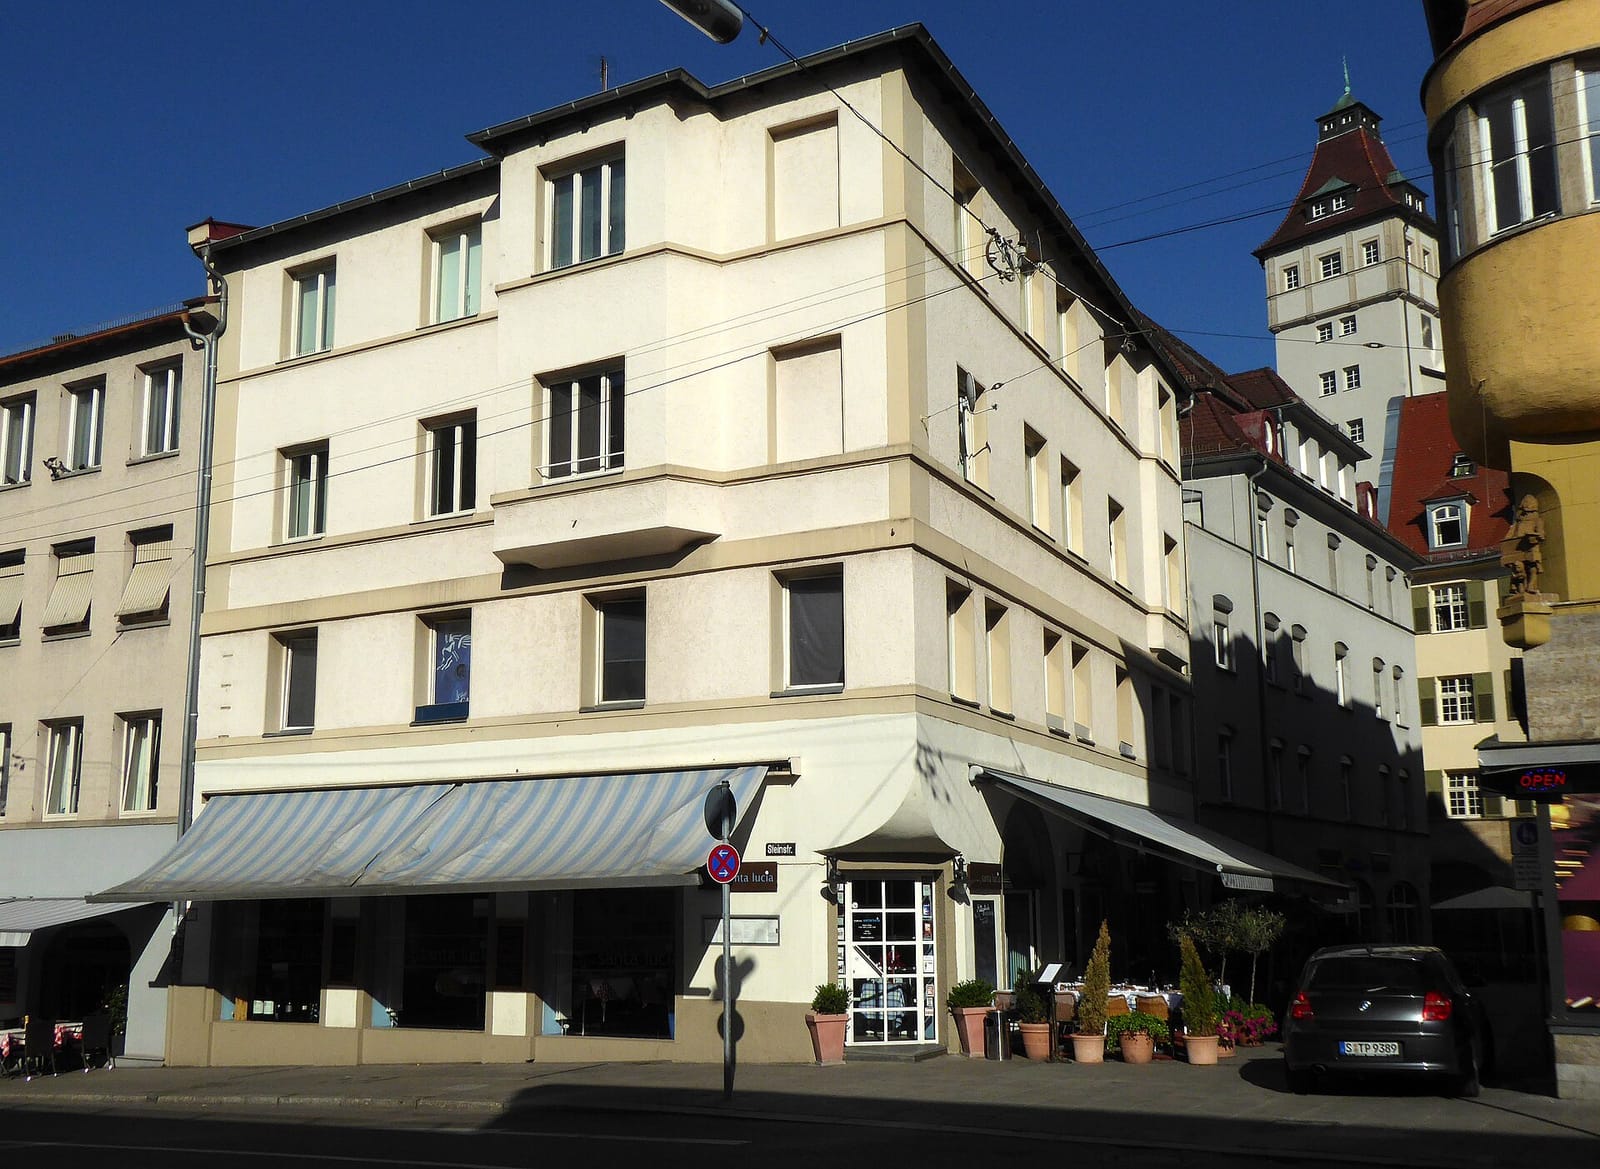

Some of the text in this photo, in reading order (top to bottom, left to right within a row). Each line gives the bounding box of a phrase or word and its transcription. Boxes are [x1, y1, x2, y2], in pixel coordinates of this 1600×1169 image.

[1520, 774, 1566, 788] OPEN
[767, 844, 793, 854] Steinstr.
[752, 870, 774, 883] lucia
[1346, 1043, 1397, 1053] S TP 9389
